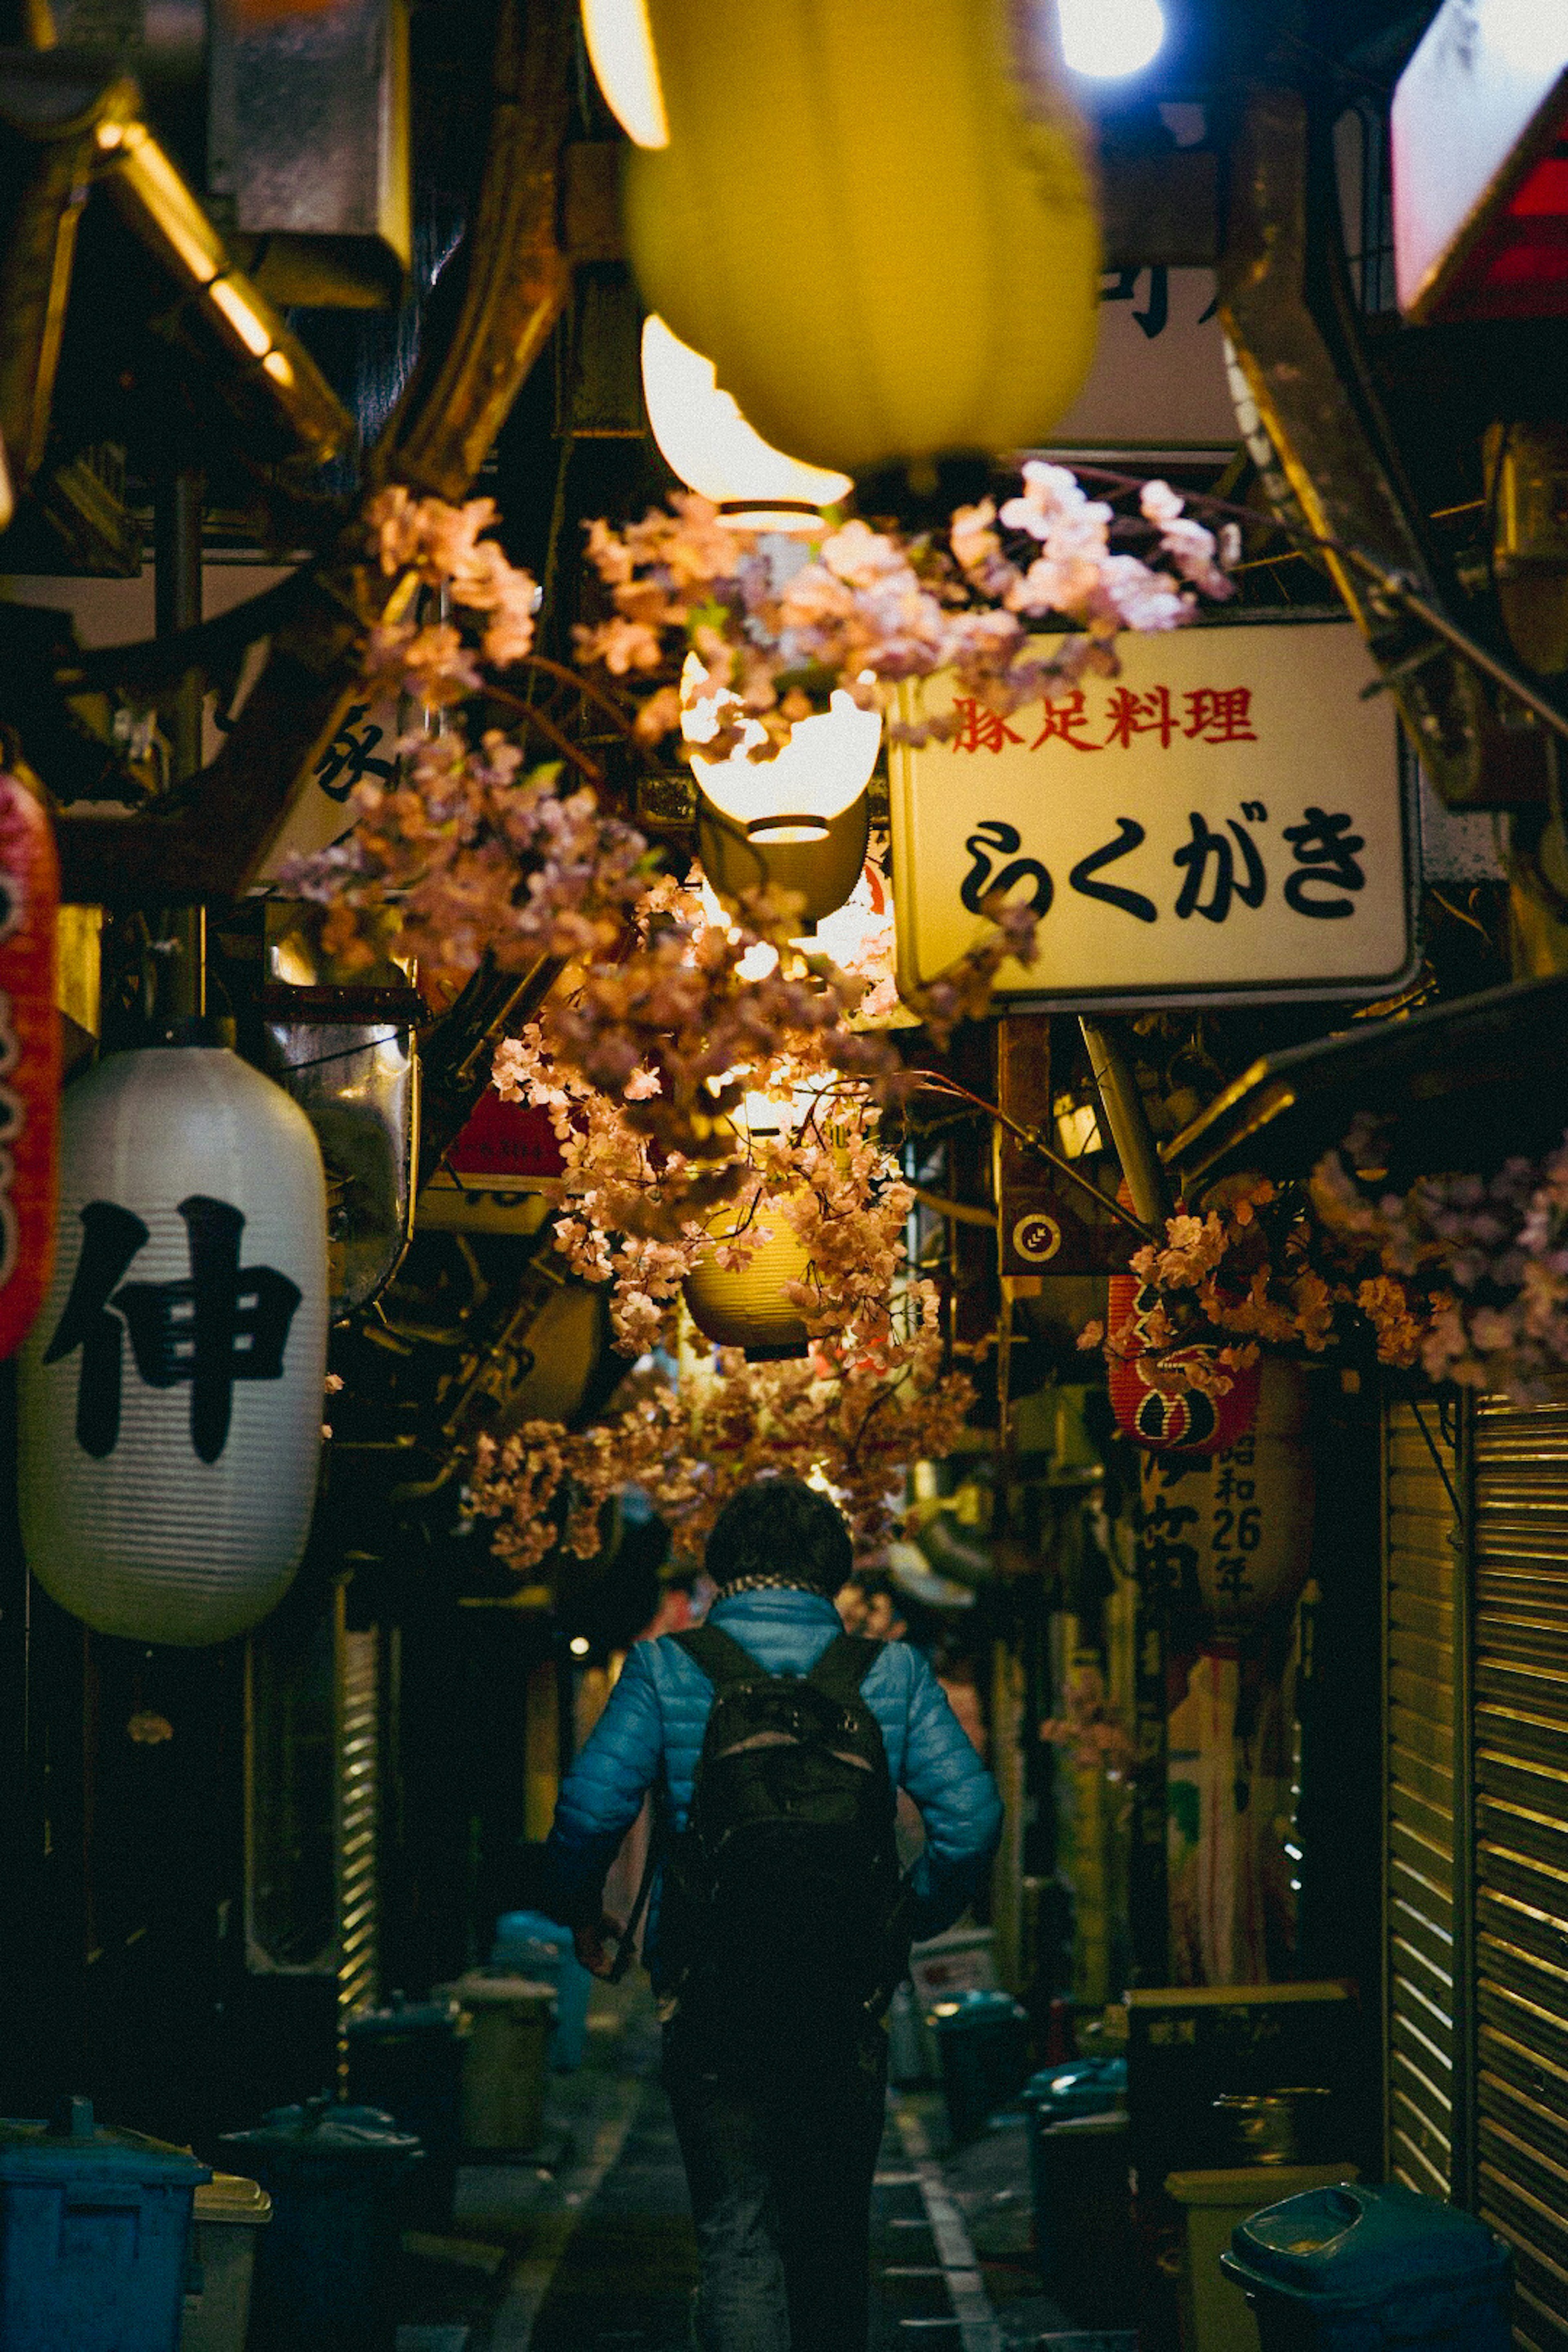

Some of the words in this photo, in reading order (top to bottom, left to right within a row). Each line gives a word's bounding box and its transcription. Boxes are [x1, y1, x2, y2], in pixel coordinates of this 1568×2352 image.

[952, 686, 1258, 755] 豚足料理
[961, 801, 1365, 923] らくがき
[43, 1195, 302, 1463] 伸
[1214, 1435, 1262, 1600] 昭和26年
